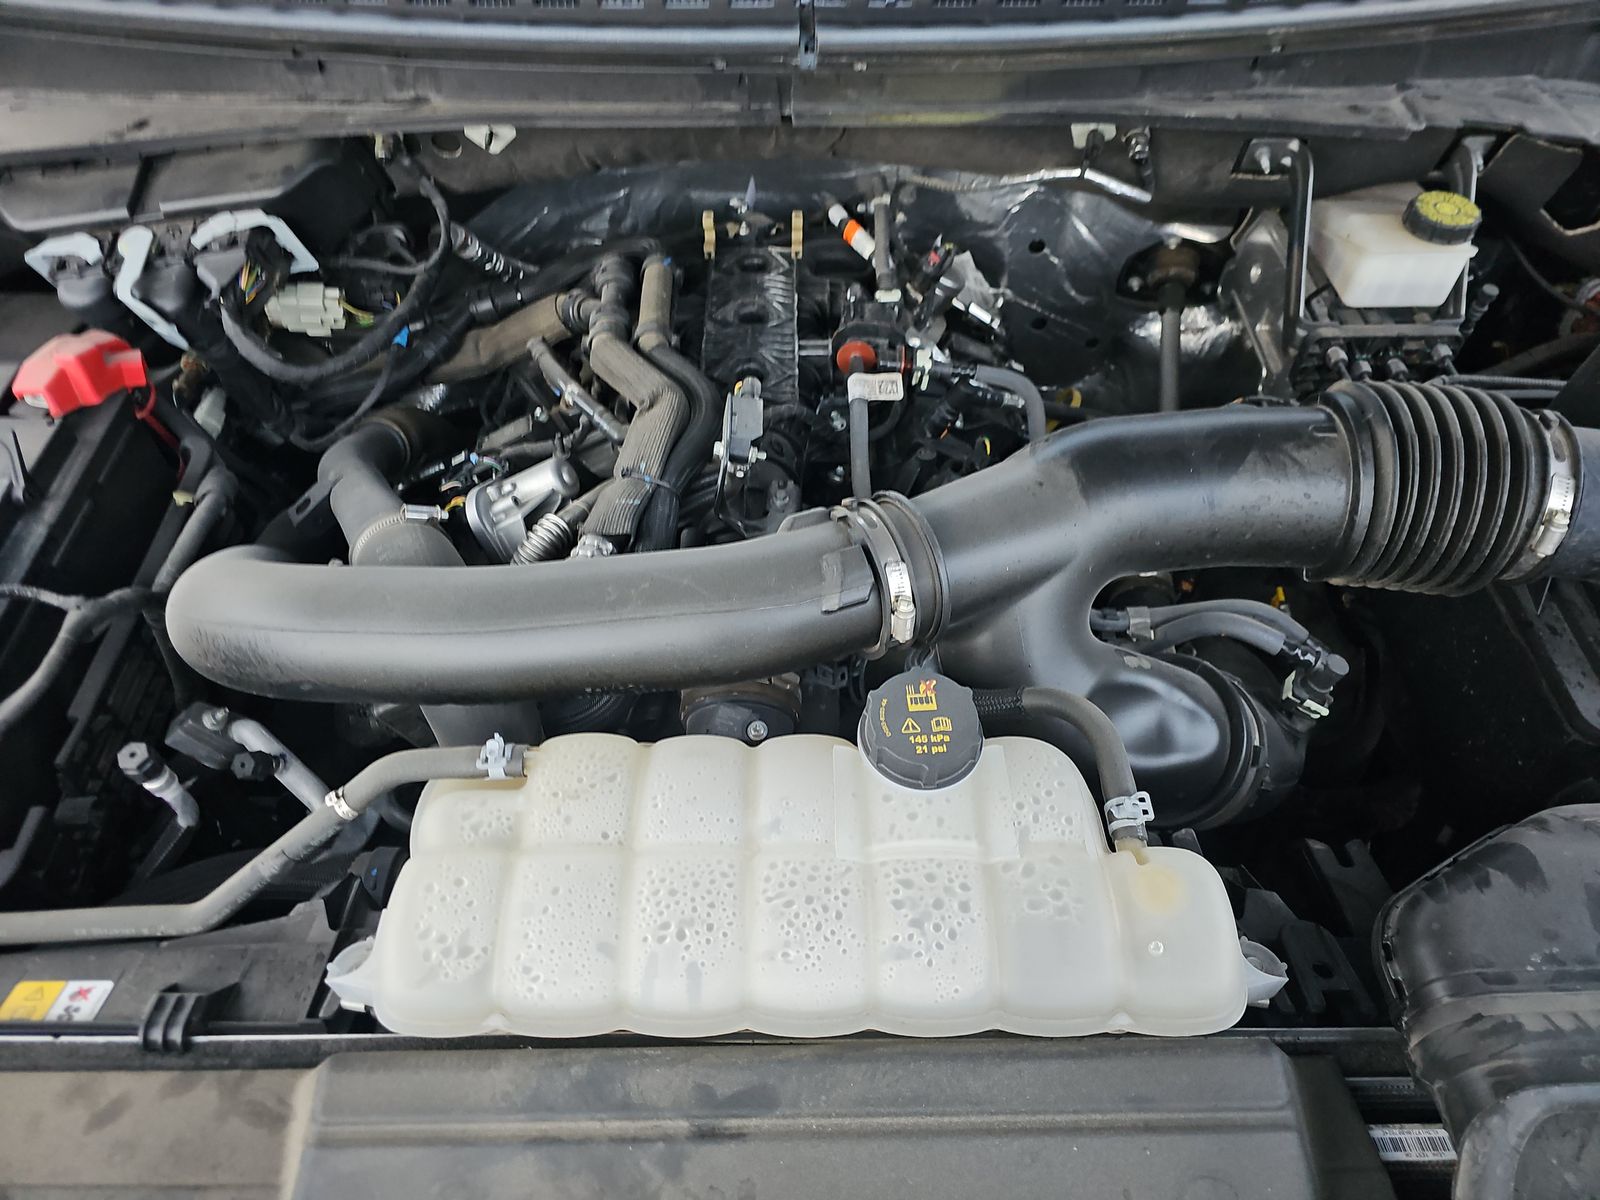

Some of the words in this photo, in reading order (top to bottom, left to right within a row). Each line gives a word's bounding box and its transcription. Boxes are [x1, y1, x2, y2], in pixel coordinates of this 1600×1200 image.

[909, 734, 928, 744] 145
[930, 734, 951, 743] kPa
[915, 744, 928, 754] 21
[931, 743, 947, 754] psi
